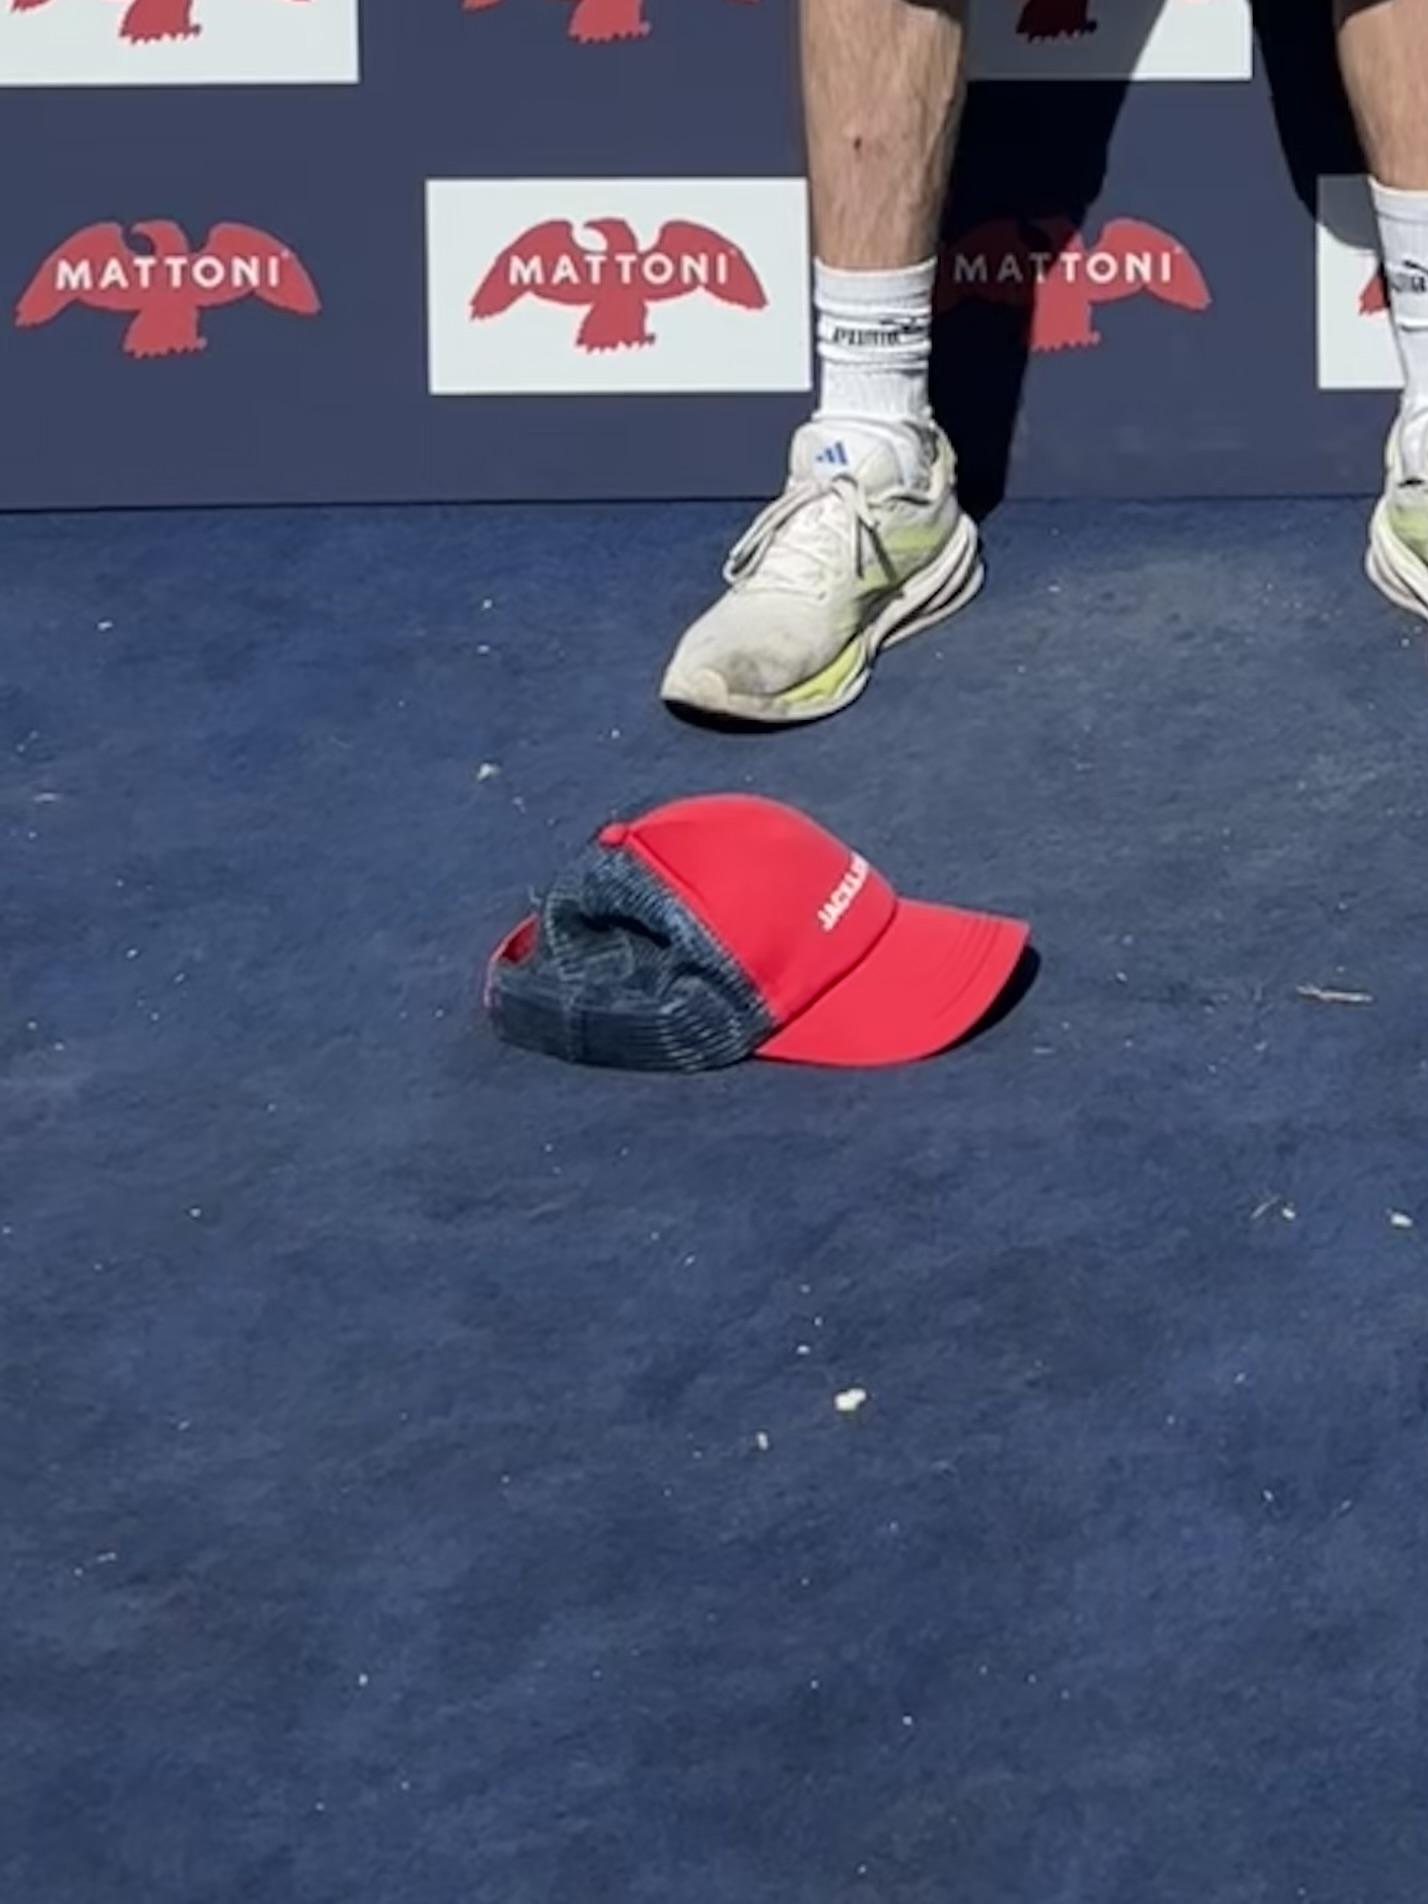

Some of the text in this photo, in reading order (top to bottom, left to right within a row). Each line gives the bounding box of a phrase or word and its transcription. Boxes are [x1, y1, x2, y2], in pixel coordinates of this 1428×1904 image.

[56, 256, 278, 290] MATTONI
[509, 253, 727, 285] MATTONI
[954, 252, 1172, 284] MATTONI
